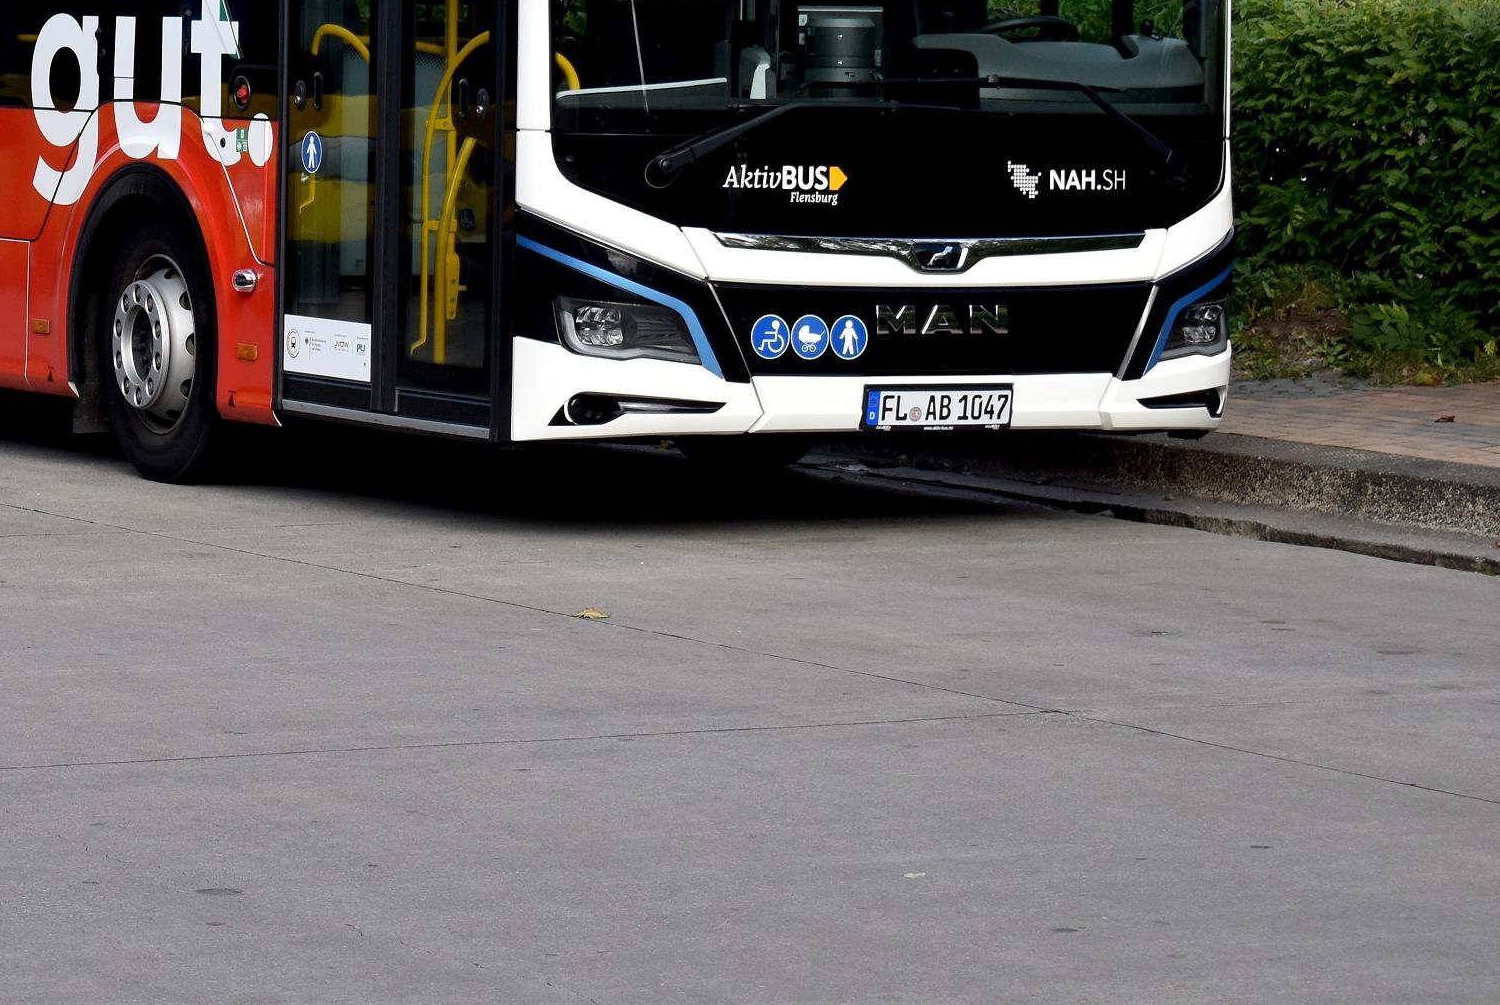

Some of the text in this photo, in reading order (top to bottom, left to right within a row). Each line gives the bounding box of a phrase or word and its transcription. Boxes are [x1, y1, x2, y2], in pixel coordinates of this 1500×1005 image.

[722, 164, 828, 190] AktivBUS
[1049, 169, 1126, 190] NAH.SH
[790, 191, 838, 206] Flensburg
[875, 304, 1008, 334] MAN
[882, 394, 1009, 420] FL AB 1047
